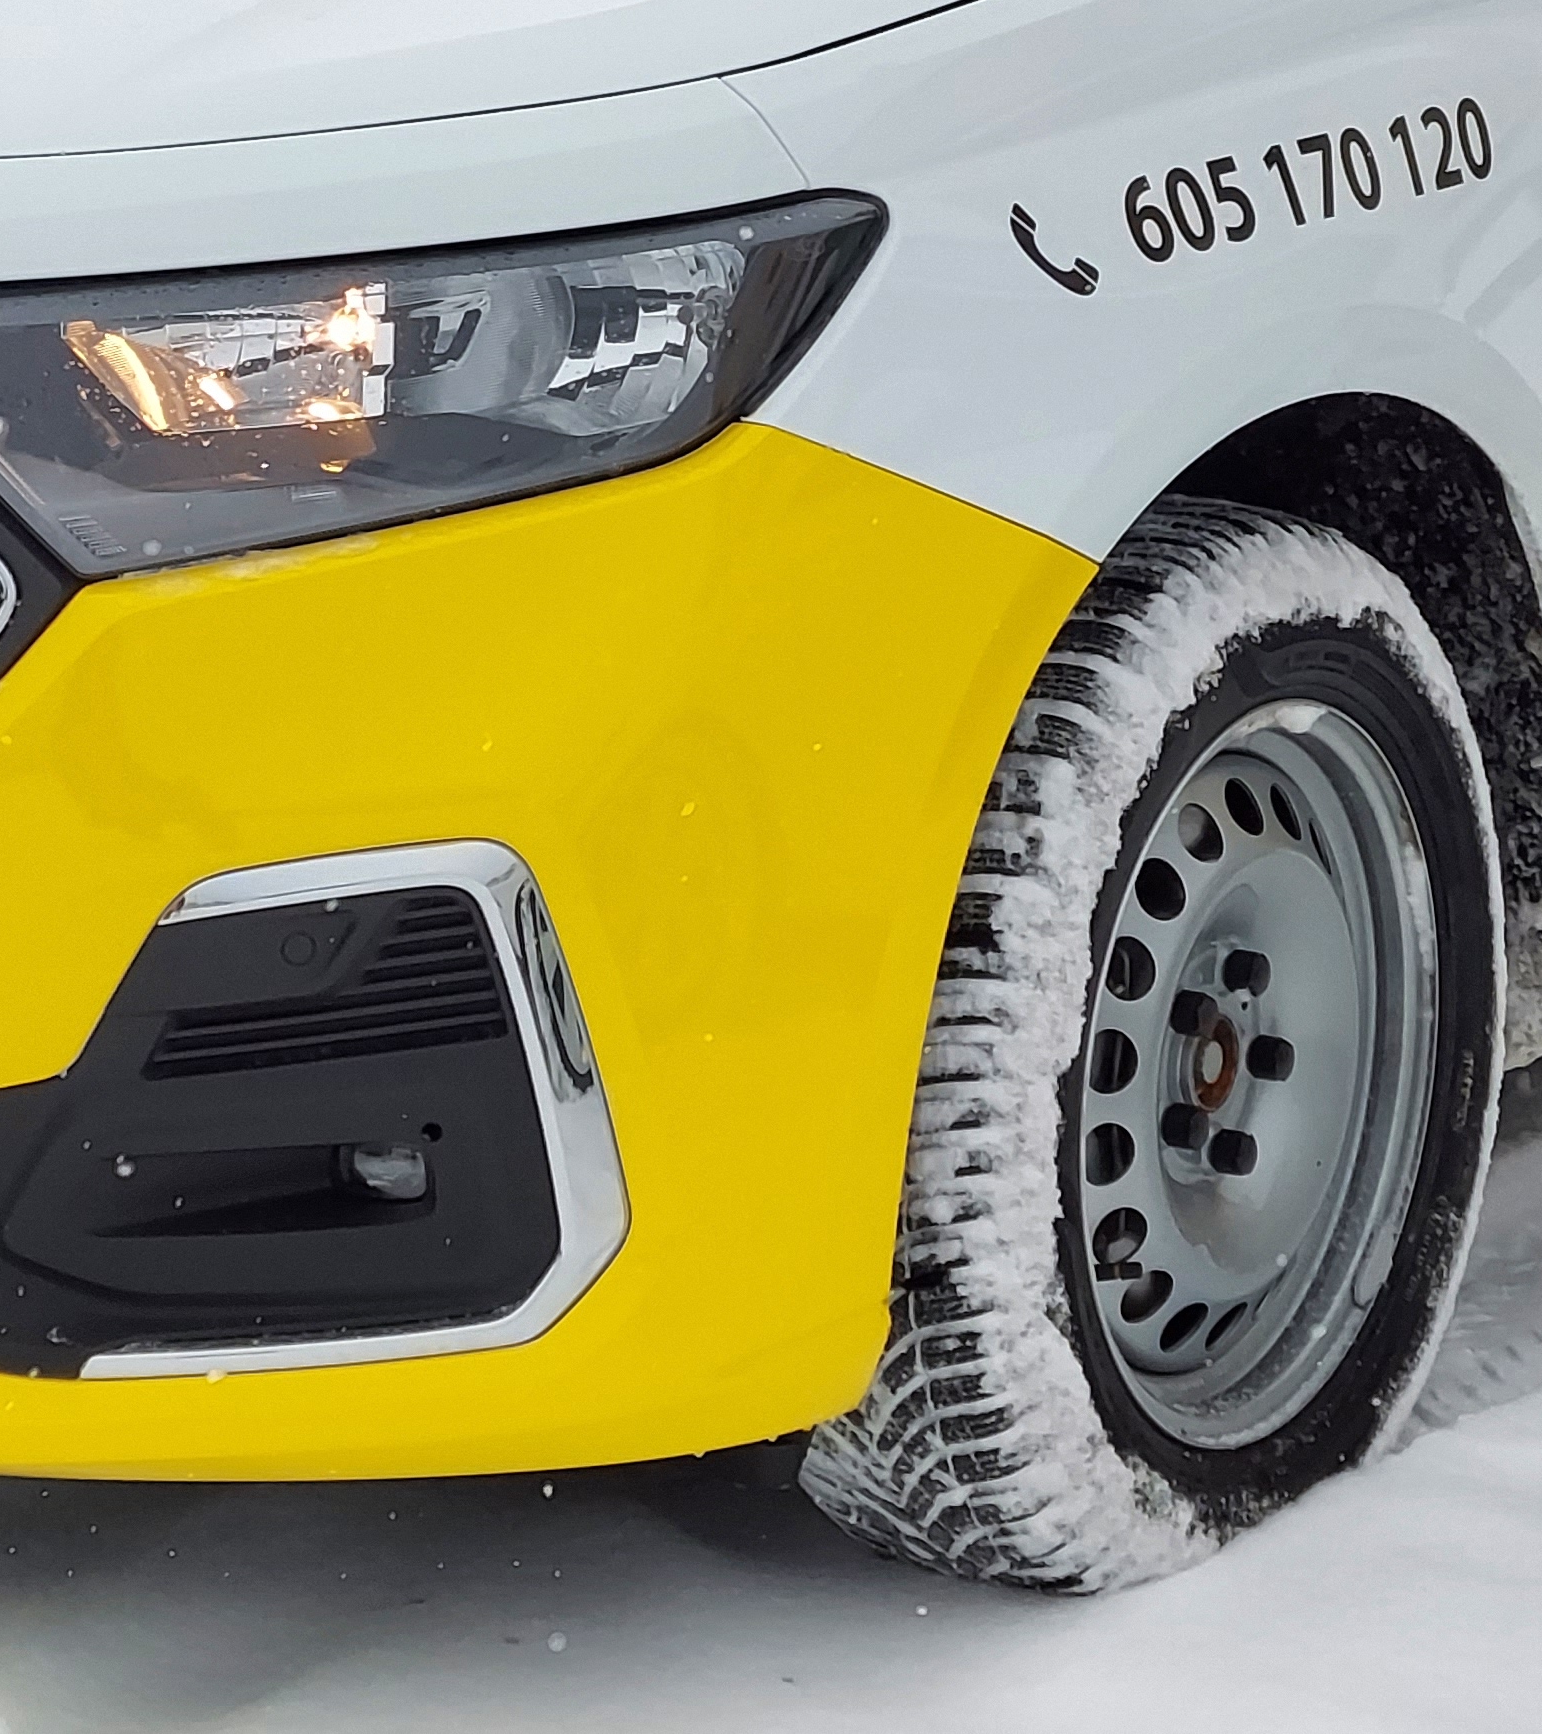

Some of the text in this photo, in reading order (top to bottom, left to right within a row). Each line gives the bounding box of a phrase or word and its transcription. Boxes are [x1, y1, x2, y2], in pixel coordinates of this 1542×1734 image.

[1123, 97, 1493, 264] 605 170 120
